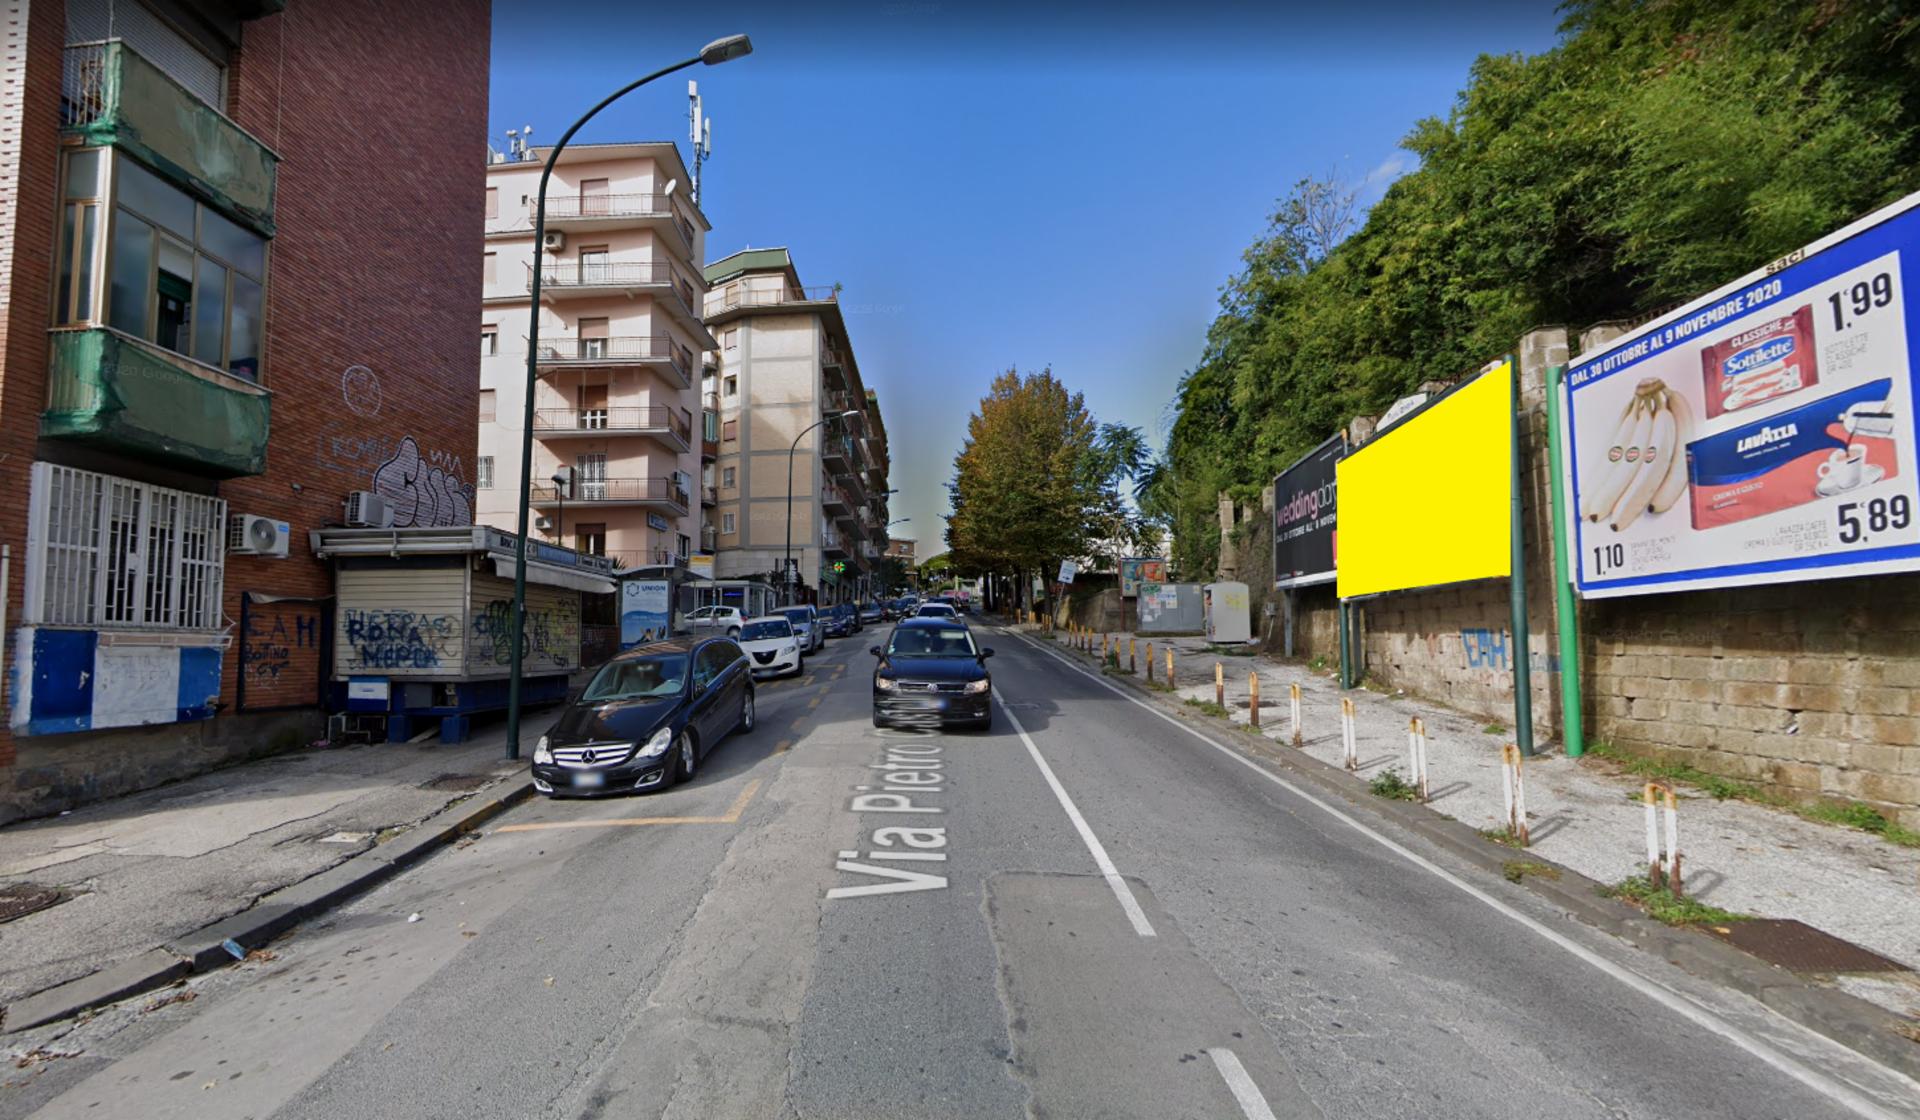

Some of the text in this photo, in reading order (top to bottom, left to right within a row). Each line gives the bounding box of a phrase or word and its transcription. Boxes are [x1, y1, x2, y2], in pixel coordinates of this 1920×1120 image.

[1571, 279, 1782, 386] DAL 30 OTTOBRE AL 9 NOVEMBRE 2020
[1731, 320, 1782, 349] CLASSICHE
[1726, 338, 1793, 374] Sottilette
[1736, 424, 1798, 453] LAVAZZA
[641, 584, 666, 592] UNION
